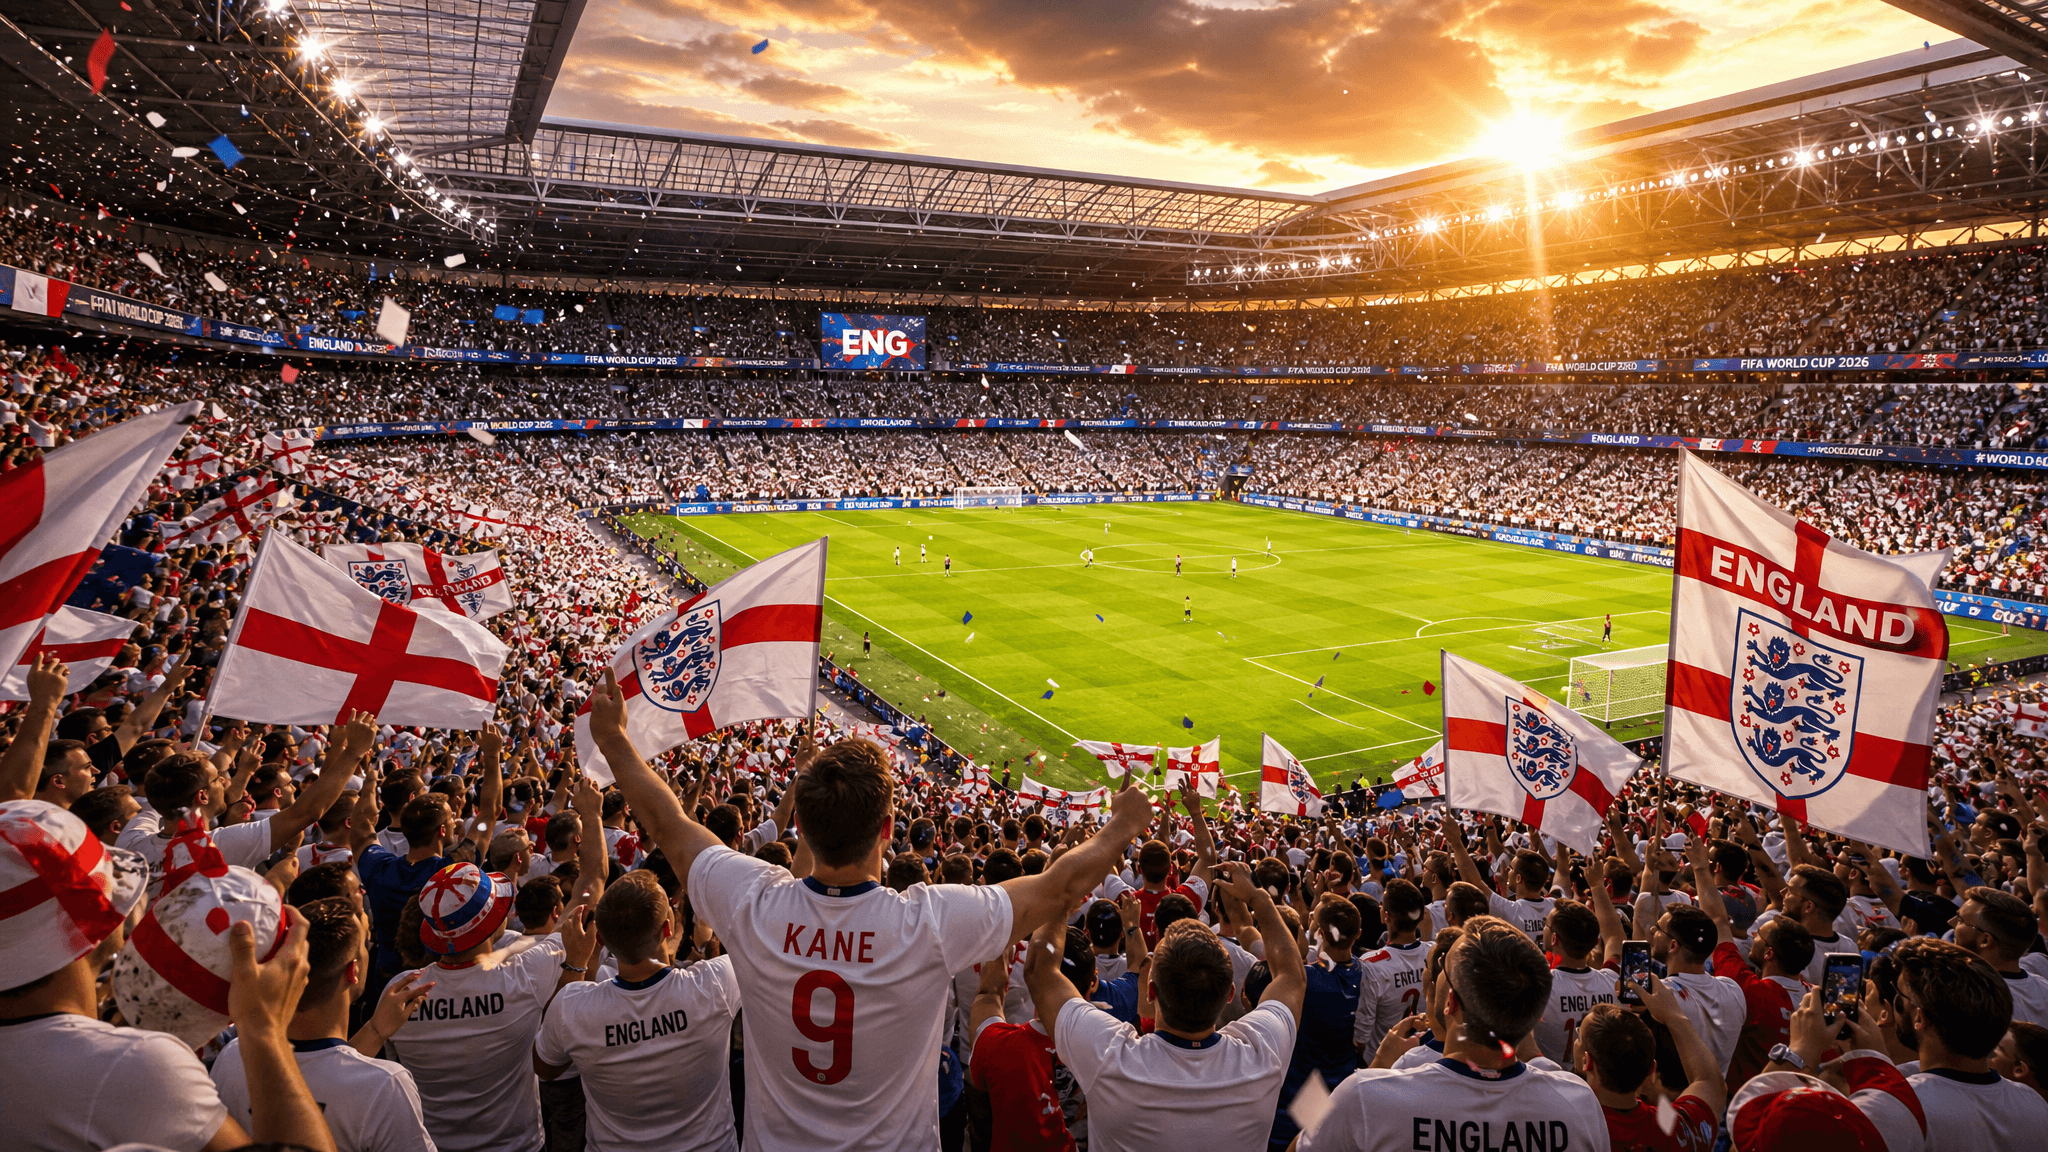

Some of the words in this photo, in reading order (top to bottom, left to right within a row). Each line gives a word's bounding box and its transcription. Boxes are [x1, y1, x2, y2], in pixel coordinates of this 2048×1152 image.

[308, 337, 353, 352] ENGLAND
[842, 329, 908, 356] ENG
[605, 356, 637, 364] WORLD
[638, 356, 656, 365] CUP
[1740, 358, 1764, 369] FIFA
[1766, 358, 1808, 369] WORLD
[1810, 357, 1836, 368] CUP
[1838, 357, 1869, 368] 2026
[1591, 434, 1640, 444] ENGLAND
[1975, 453, 2035, 466] #WORLD
[1711, 545, 1915, 645] ENGLAND
[783, 922, 875, 963] KANE
[1560, 994, 1613, 1013] ENGLAND
[605, 1009, 688, 1047] ENGLAND
[792, 969, 855, 1086] 9
[1413, 1116, 1569, 1152] ENGLAND
